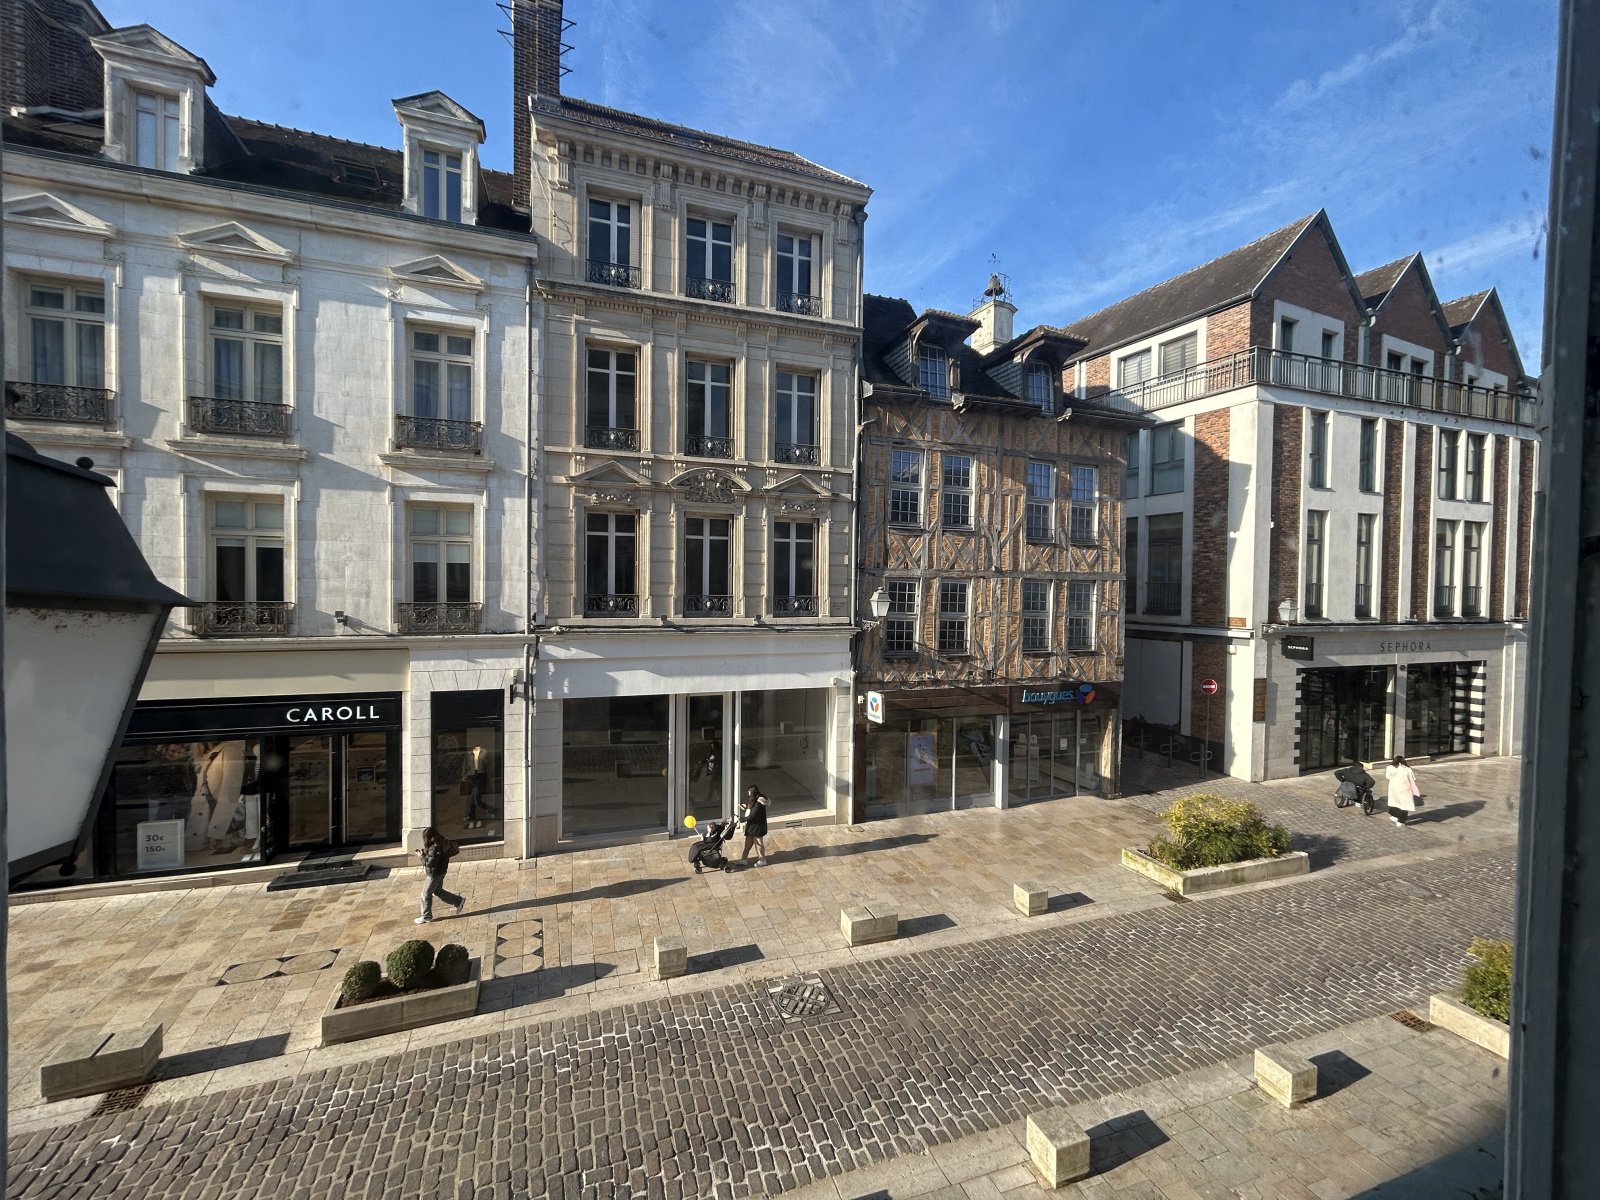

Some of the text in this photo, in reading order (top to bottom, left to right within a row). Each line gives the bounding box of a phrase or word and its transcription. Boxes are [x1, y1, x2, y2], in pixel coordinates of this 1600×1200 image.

[1380, 641, 1431, 652] SEPHORA
[1021, 689, 1074, 705] bouygues
[286, 705, 380, 723] CAROLL
